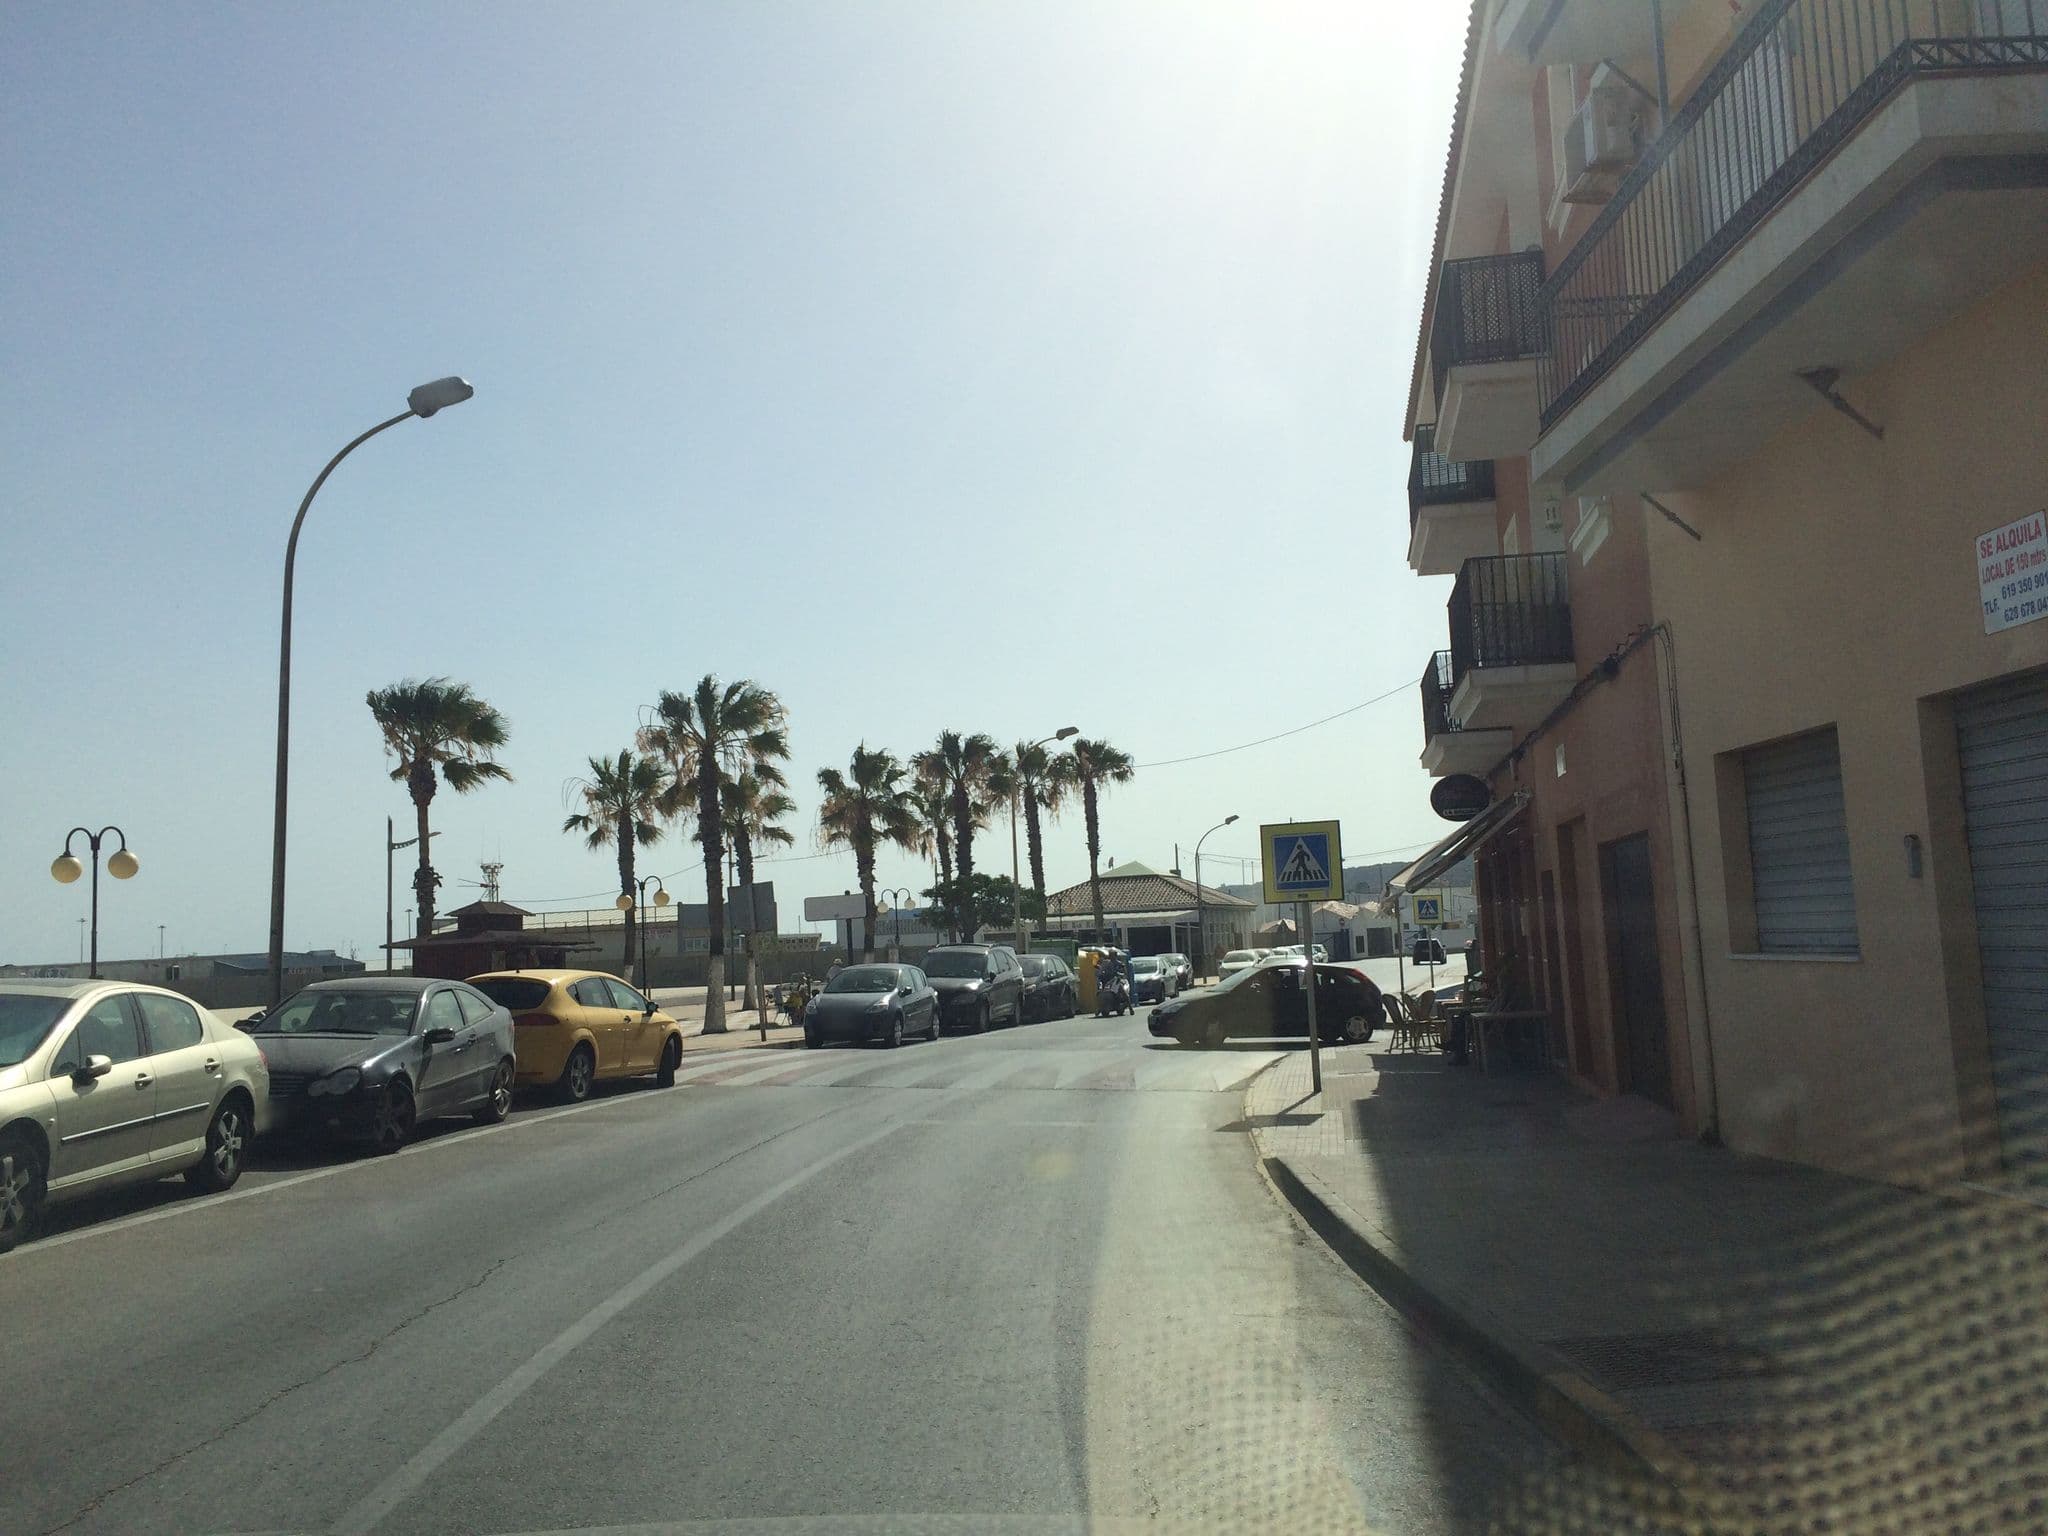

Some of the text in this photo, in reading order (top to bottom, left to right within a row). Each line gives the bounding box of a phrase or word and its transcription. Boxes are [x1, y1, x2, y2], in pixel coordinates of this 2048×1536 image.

[1980, 520, 2041, 558] SE ALQUILA
[1982, 562, 2004, 584] LOCAL
[2005, 557, 2015, 575] DE
[2002, 582, 2016, 599] 619
[2018, 577, 2032, 594] 350
[1984, 598, 1999, 615] TLF.
[2021, 601, 2035, 617] 678
[2037, 597, 2048, 612] 04
